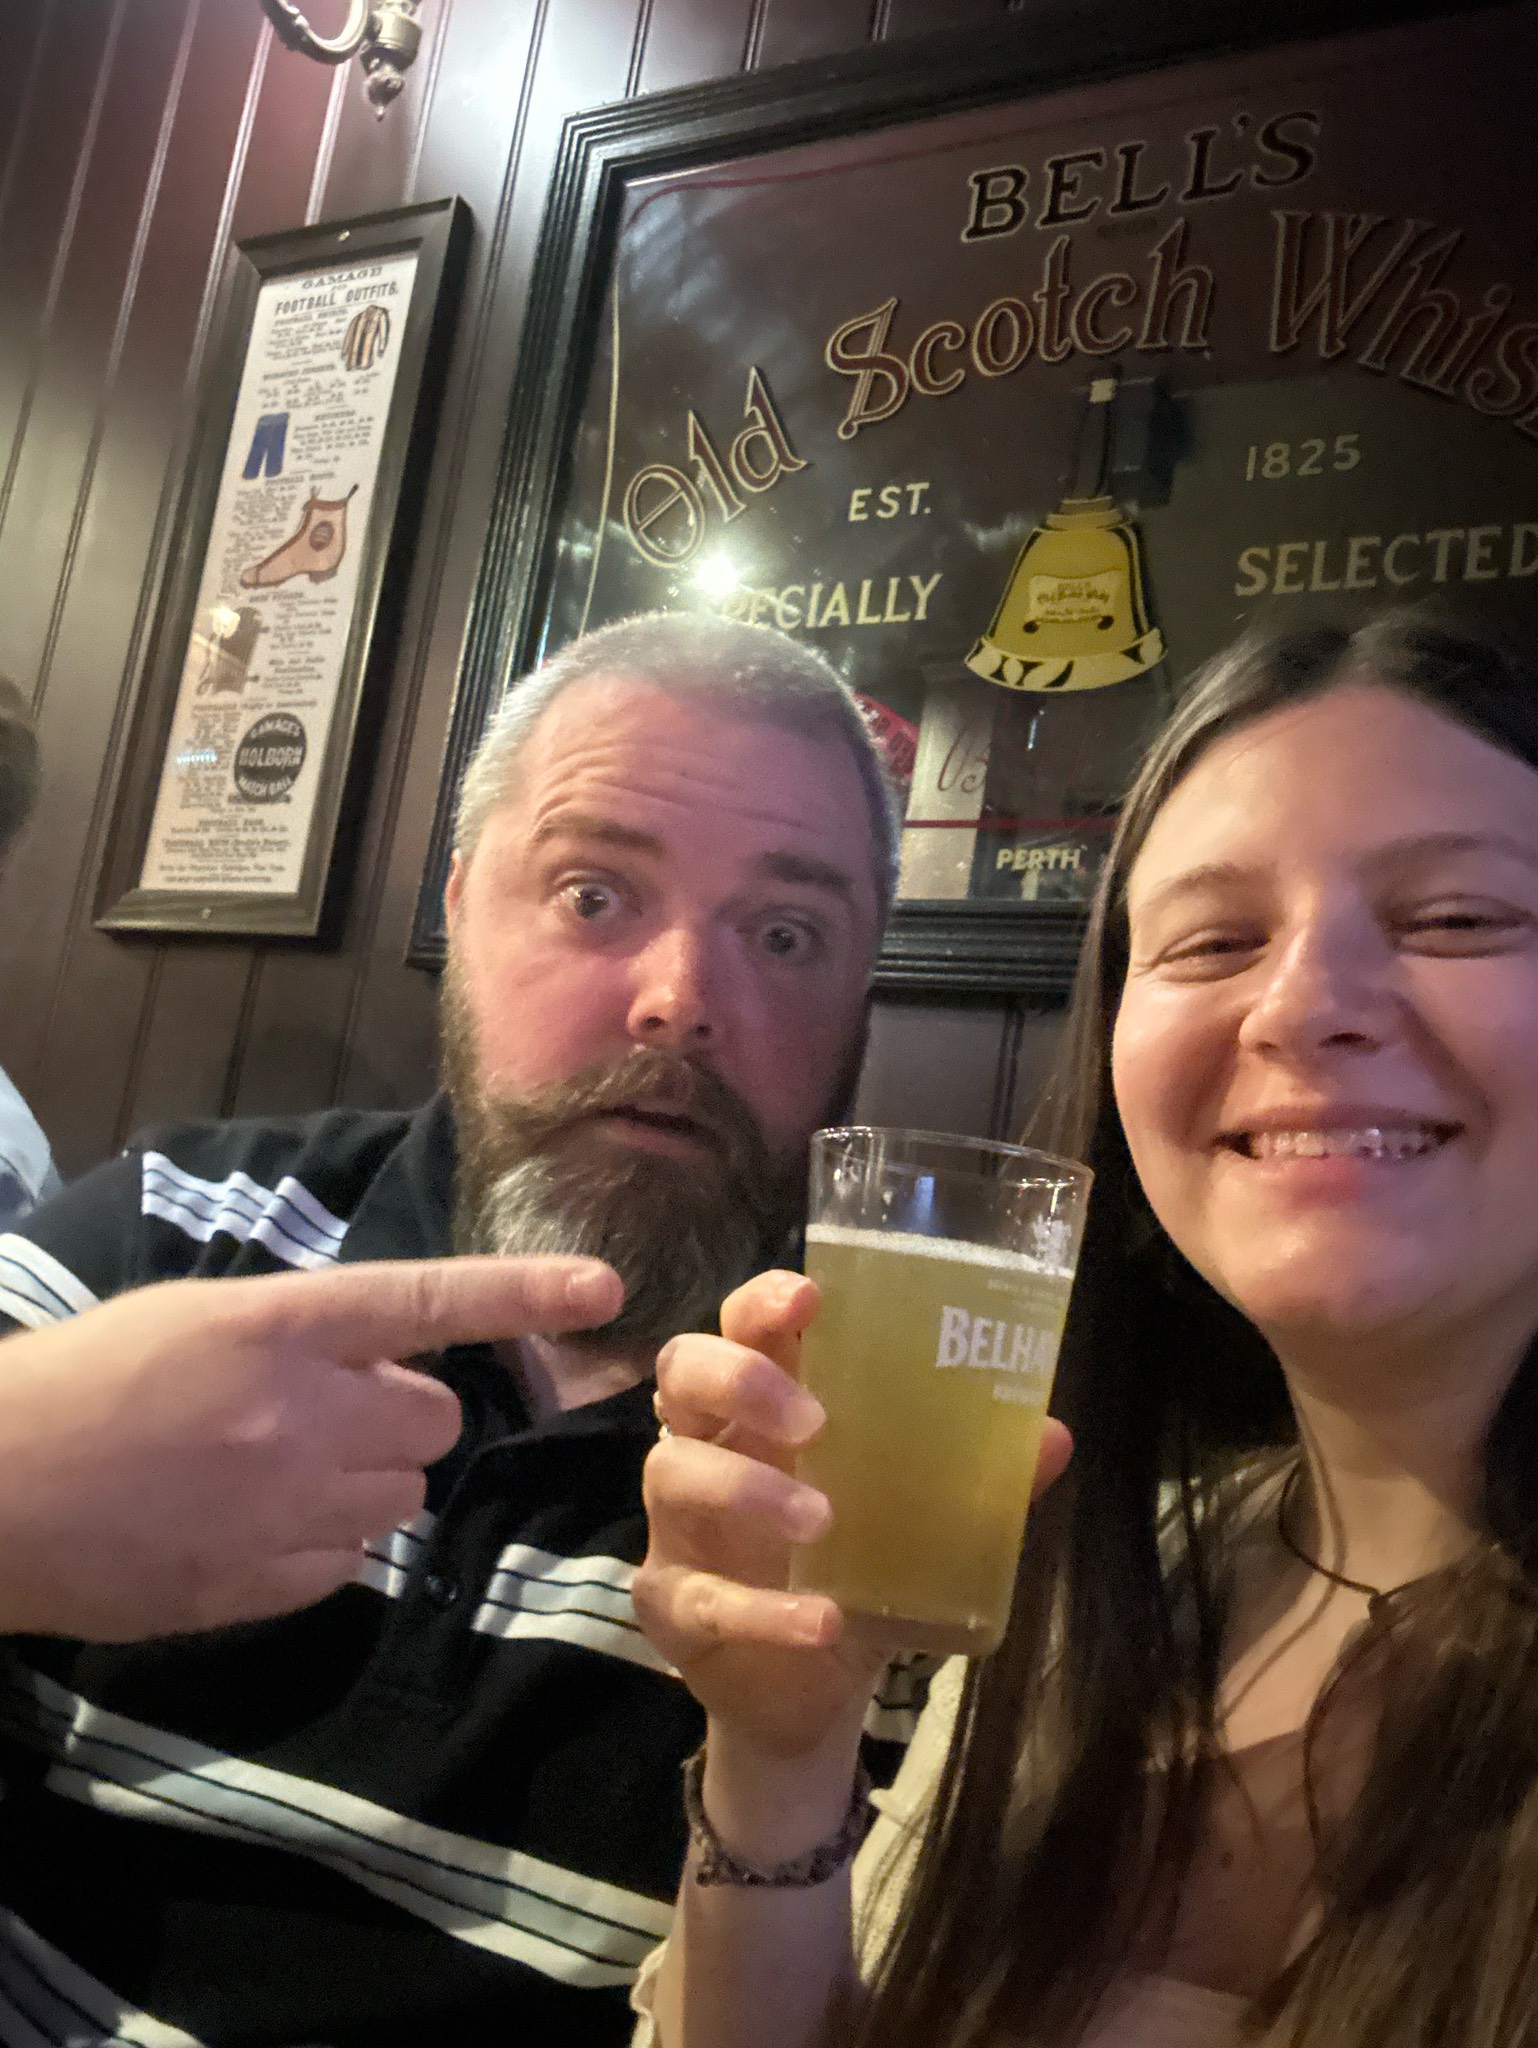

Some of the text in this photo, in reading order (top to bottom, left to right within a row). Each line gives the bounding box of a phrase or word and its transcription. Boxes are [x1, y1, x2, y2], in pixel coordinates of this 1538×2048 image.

[961, 111, 1321, 243] BELL'S
[275, 293, 336, 315] FOOTBALL
[622, 209, 1538, 568] Old Scotch Whis
[849, 433, 1361, 521] EST. 1825
[995, 848, 1081, 872] PERTH
